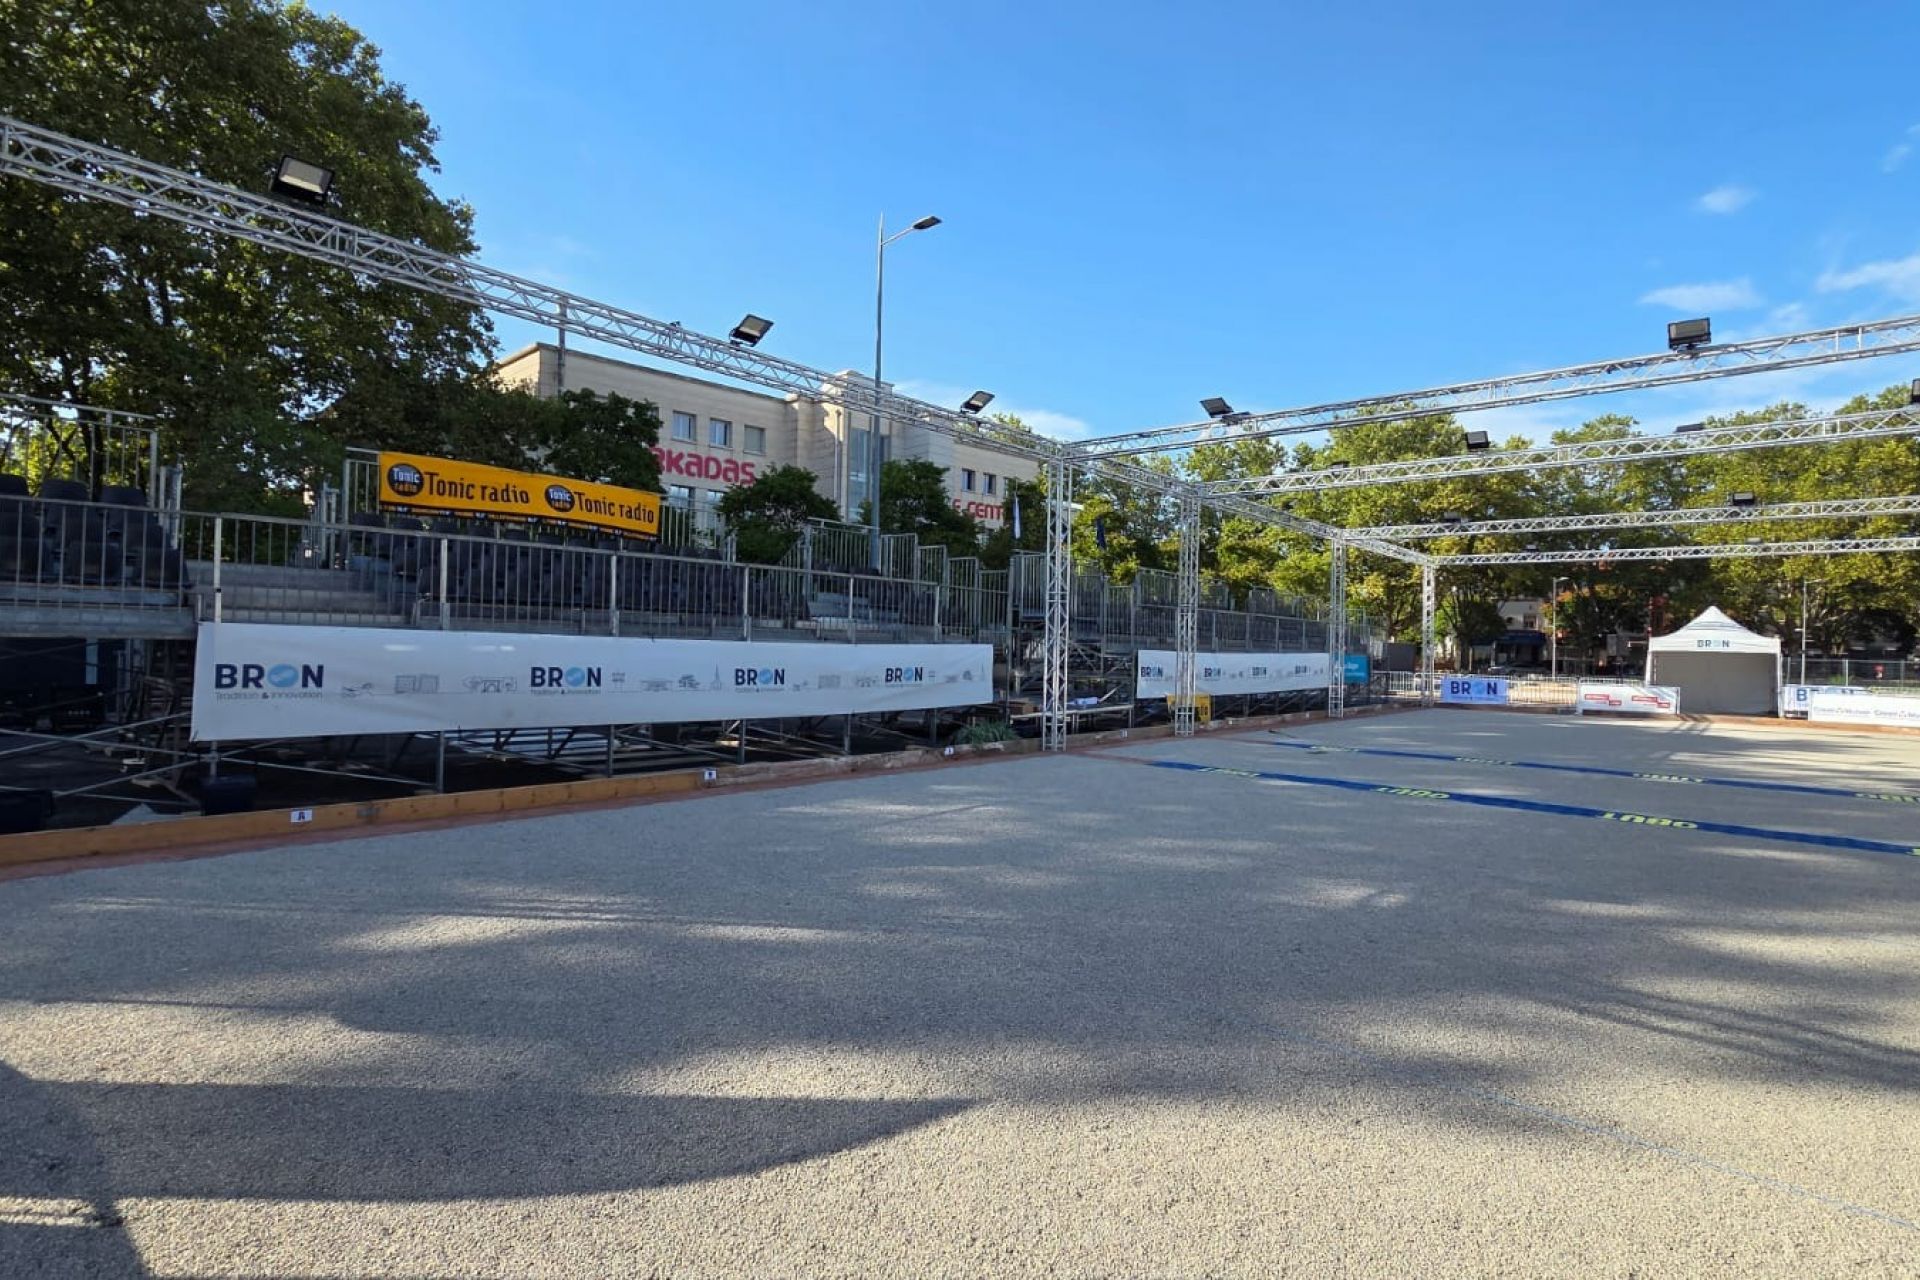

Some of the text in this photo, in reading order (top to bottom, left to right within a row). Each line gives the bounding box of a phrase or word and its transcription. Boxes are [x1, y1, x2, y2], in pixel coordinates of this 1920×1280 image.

[424, 471, 530, 504] Tonic radio
[574, 491, 654, 524] Tonic radio
[1697, 639, 1730, 648] BRON
[215, 663, 324, 689] BRON
[531, 666, 602, 687] BRON
[735, 668, 785, 685] BRON
[885, 666, 923, 683] BRON
[1451, 681, 1498, 695] BRON
